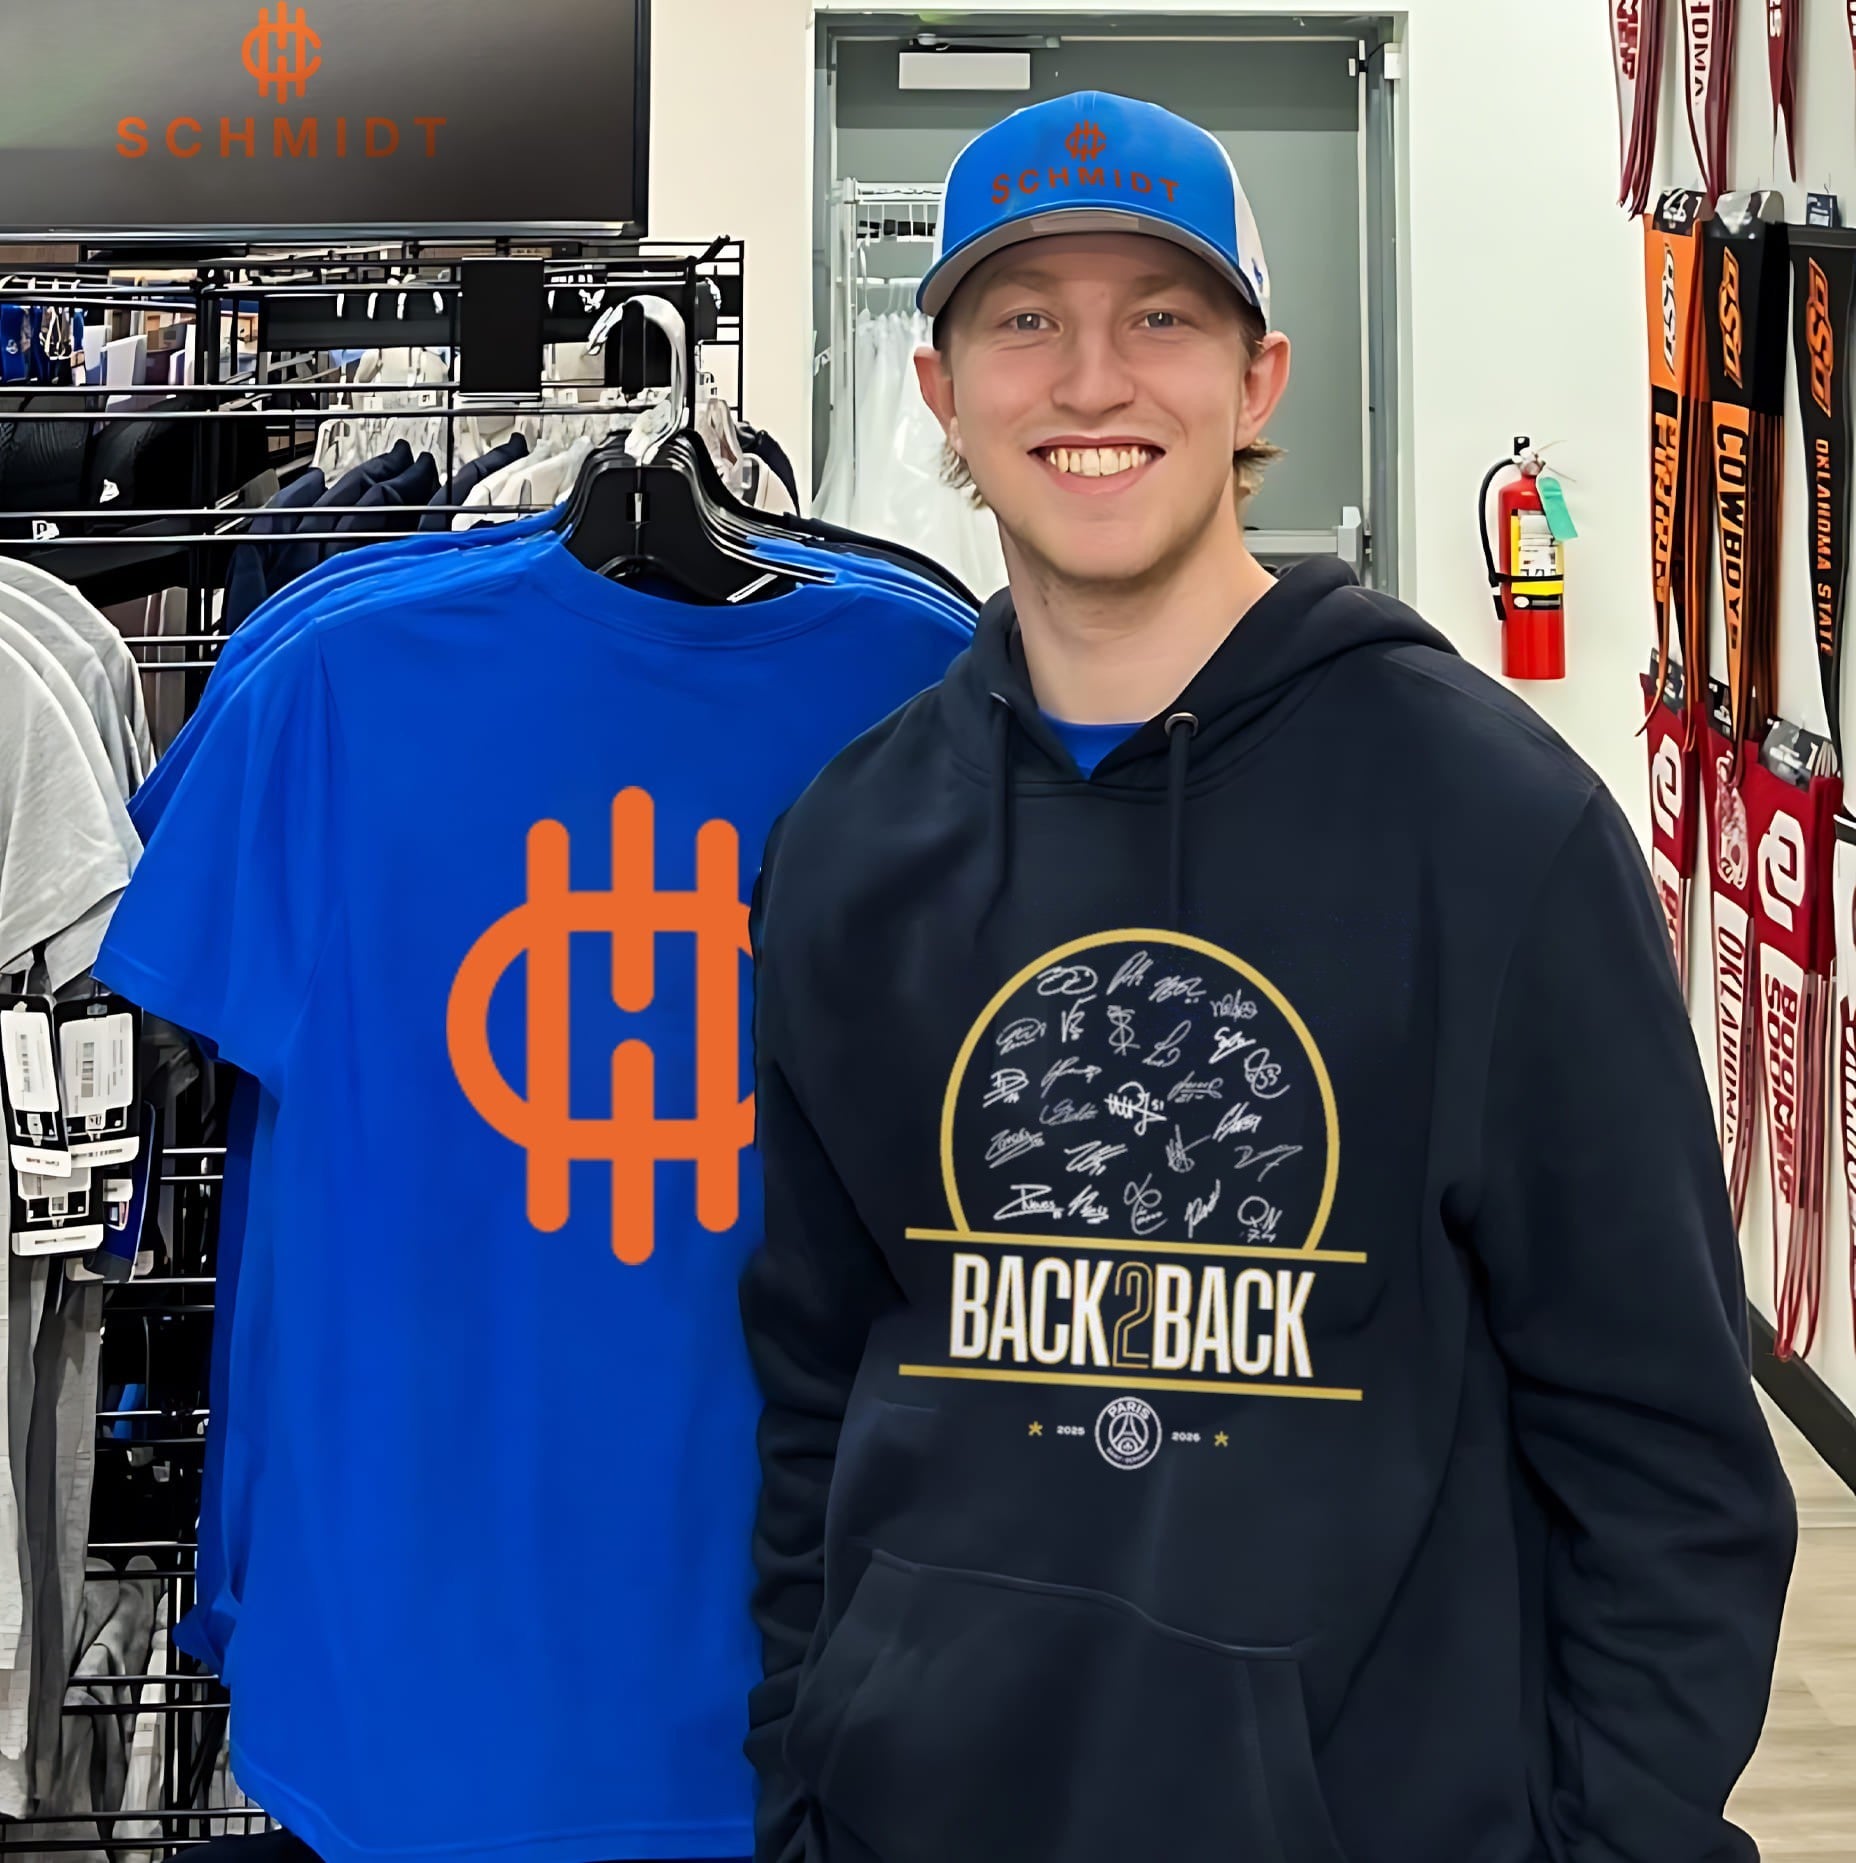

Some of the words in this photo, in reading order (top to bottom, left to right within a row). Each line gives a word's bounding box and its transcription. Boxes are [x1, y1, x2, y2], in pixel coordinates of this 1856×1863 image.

[115, 116, 447, 158] SCHMIDT
[991, 166, 1179, 204] SCHMIDT
[1815, 438, 1831, 570] OKLAHOMA
[1718, 926, 1745, 1143] OKLAHOMA
[1107, 1401, 1150, 1420] PARIS
[1056, 1425, 1085, 1436] 2025
[1171, 1431, 1201, 1442] 2026
